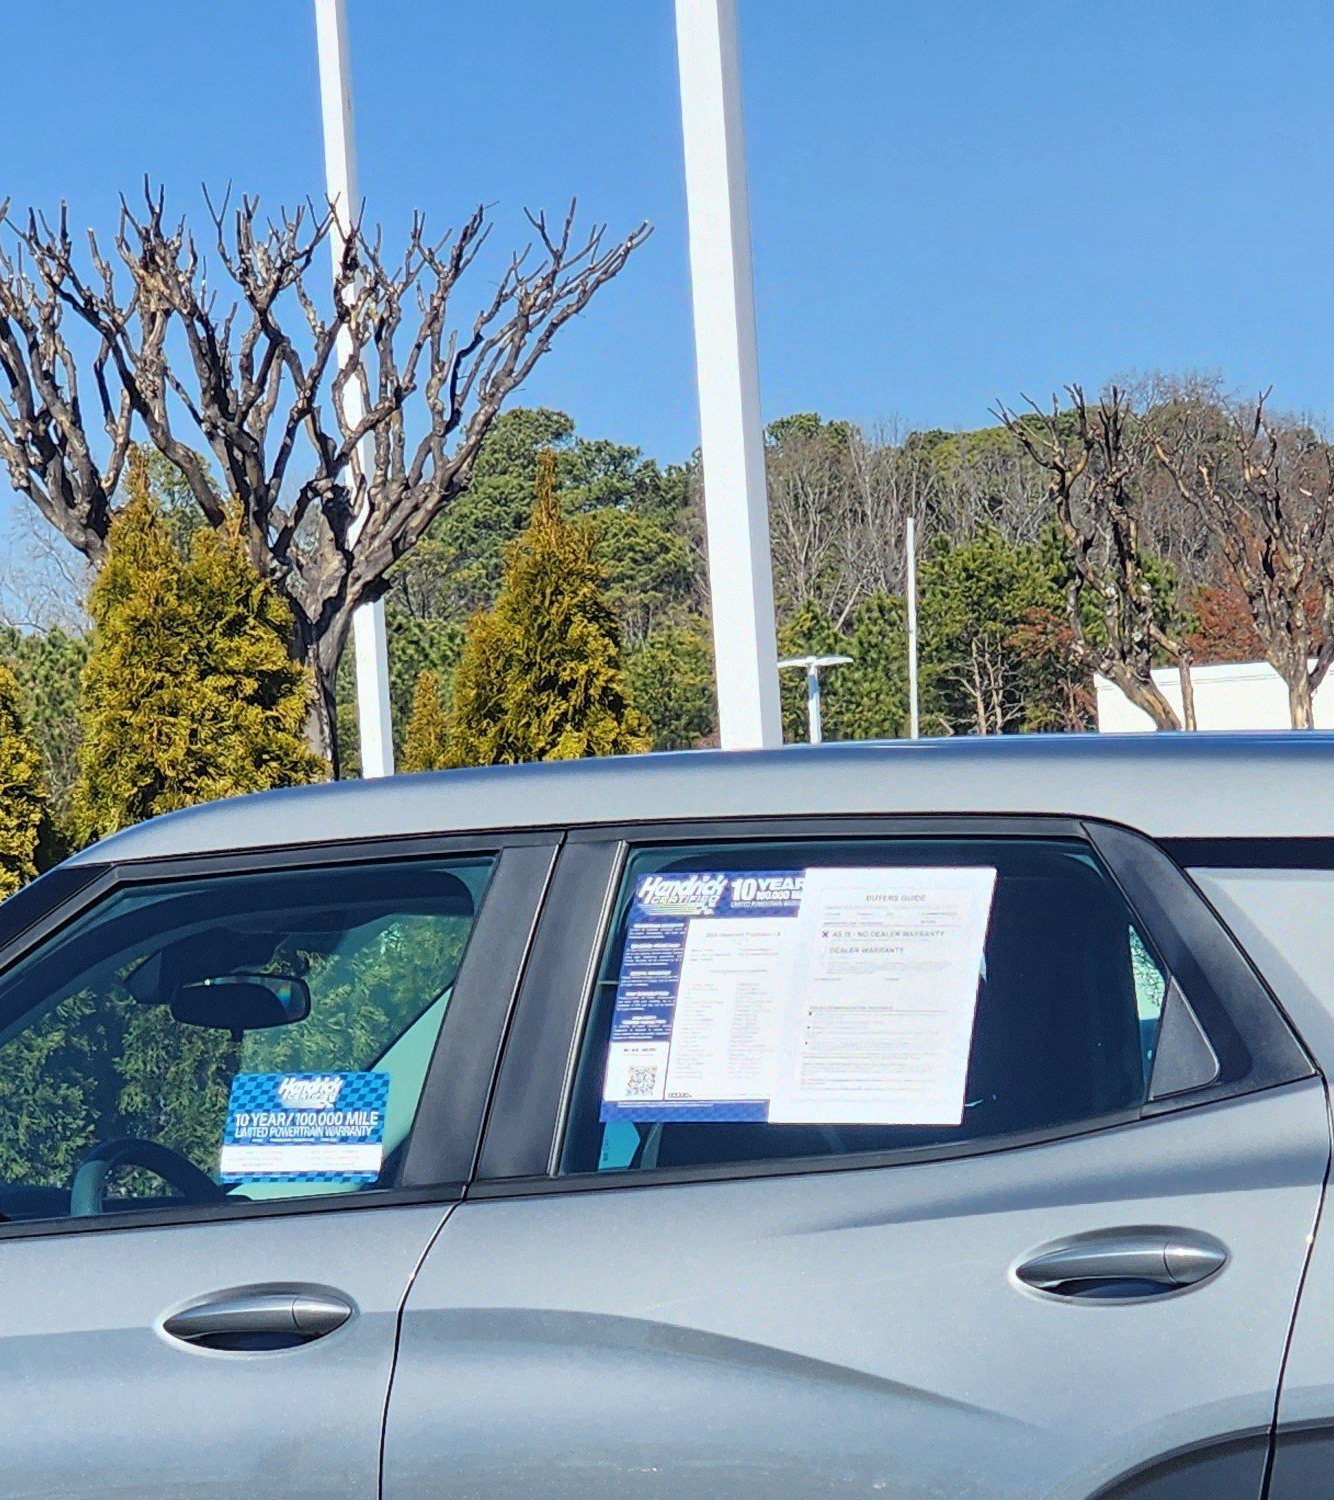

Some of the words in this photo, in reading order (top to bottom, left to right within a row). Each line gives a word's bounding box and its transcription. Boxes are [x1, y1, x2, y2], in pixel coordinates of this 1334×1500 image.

[639, 874, 728, 900] Hendrick
[731, 878, 757, 900] 10
[235, 1113, 249, 1127] 10
[346, 1111, 379, 1126] MILE
[235, 1127, 268, 1138] LIMITED
[270, 1126, 323, 1137] POWERTRAIN
[326, 1125, 373, 1137] WARRANTY
